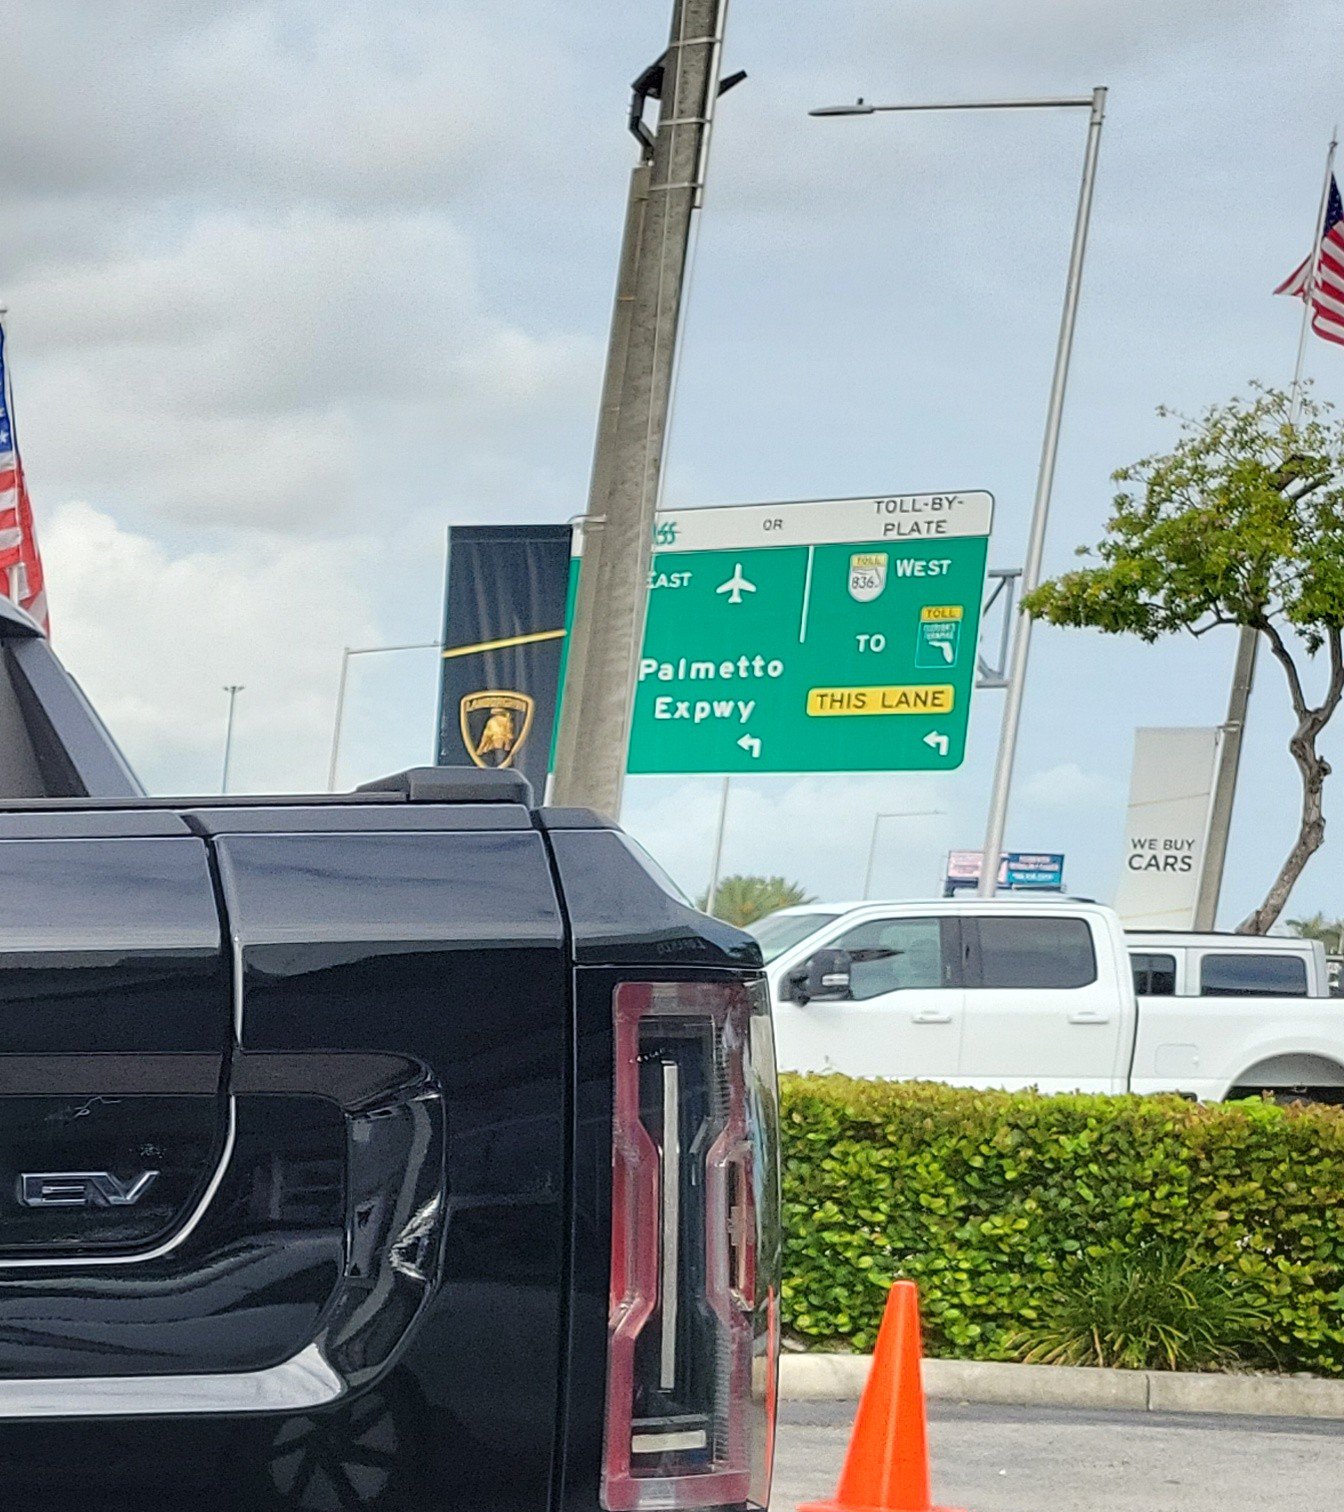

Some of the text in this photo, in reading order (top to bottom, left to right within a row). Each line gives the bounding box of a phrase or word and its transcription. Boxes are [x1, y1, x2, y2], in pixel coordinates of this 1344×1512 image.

[763, 519, 783, 531] OR
[883, 520, 947, 536] PLATE
[896, 558, 951, 578] WEST
[851, 576, 875, 589] 836
[926, 608, 957, 618] TOLL
[856, 634, 886, 652] TO
[639, 655, 784, 682] Palmetto
[817, 690, 944, 710] THIS LANE
[654, 696, 756, 724] Expwy
[1131, 839, 1195, 851] WE BUY
[1128, 854, 1193, 872] CARS
[20, 1169, 159, 1207] EV
